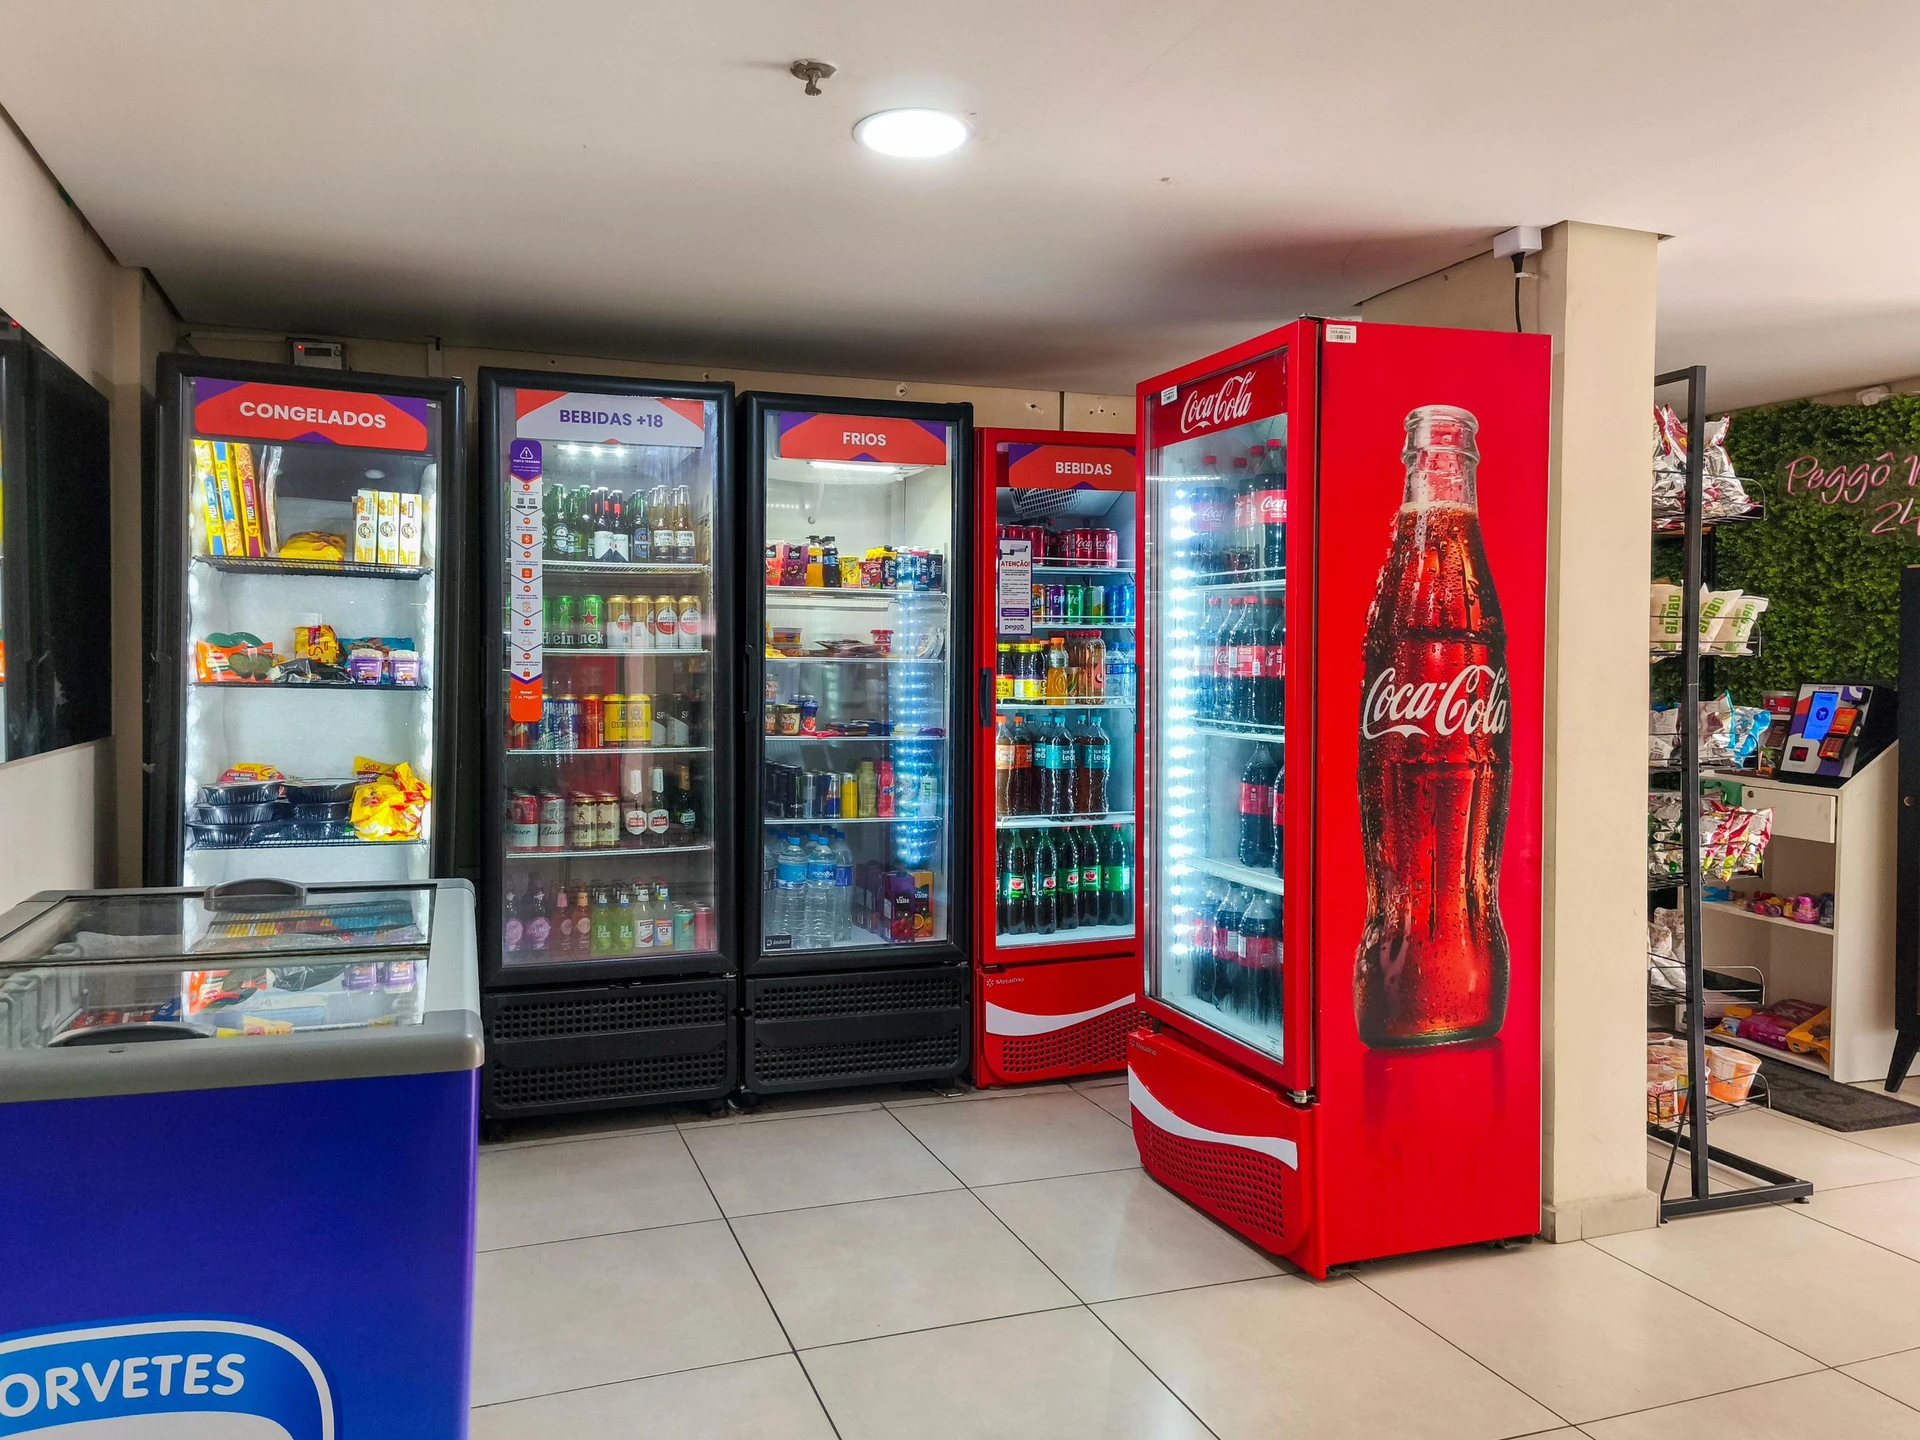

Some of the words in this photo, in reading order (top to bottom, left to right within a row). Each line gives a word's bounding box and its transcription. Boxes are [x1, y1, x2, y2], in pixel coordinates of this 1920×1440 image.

[239, 401, 387, 429] CONGELADOS
[1180, 369, 1257, 434] Coca-Cola
[559, 409, 632, 426] BEBIDAS
[636, 414, 664, 428] +18
[842, 431, 887, 447] FRIOS
[1055, 461, 1113, 475] BEBIDAS
[1784, 451, 1897, 505] Peggô
[1000, 560, 1031, 568] ATENÇÃO!
[1665, 595, 1681, 634] GLOBO
[1699, 597, 1726, 634] GLOBO
[1359, 664, 1508, 740] Coca-Cola
[363, 762, 381, 771] Sadia
[995, 975, 1025, 985] Metalfrio
[0, 1353, 246, 1418] ORVETES
